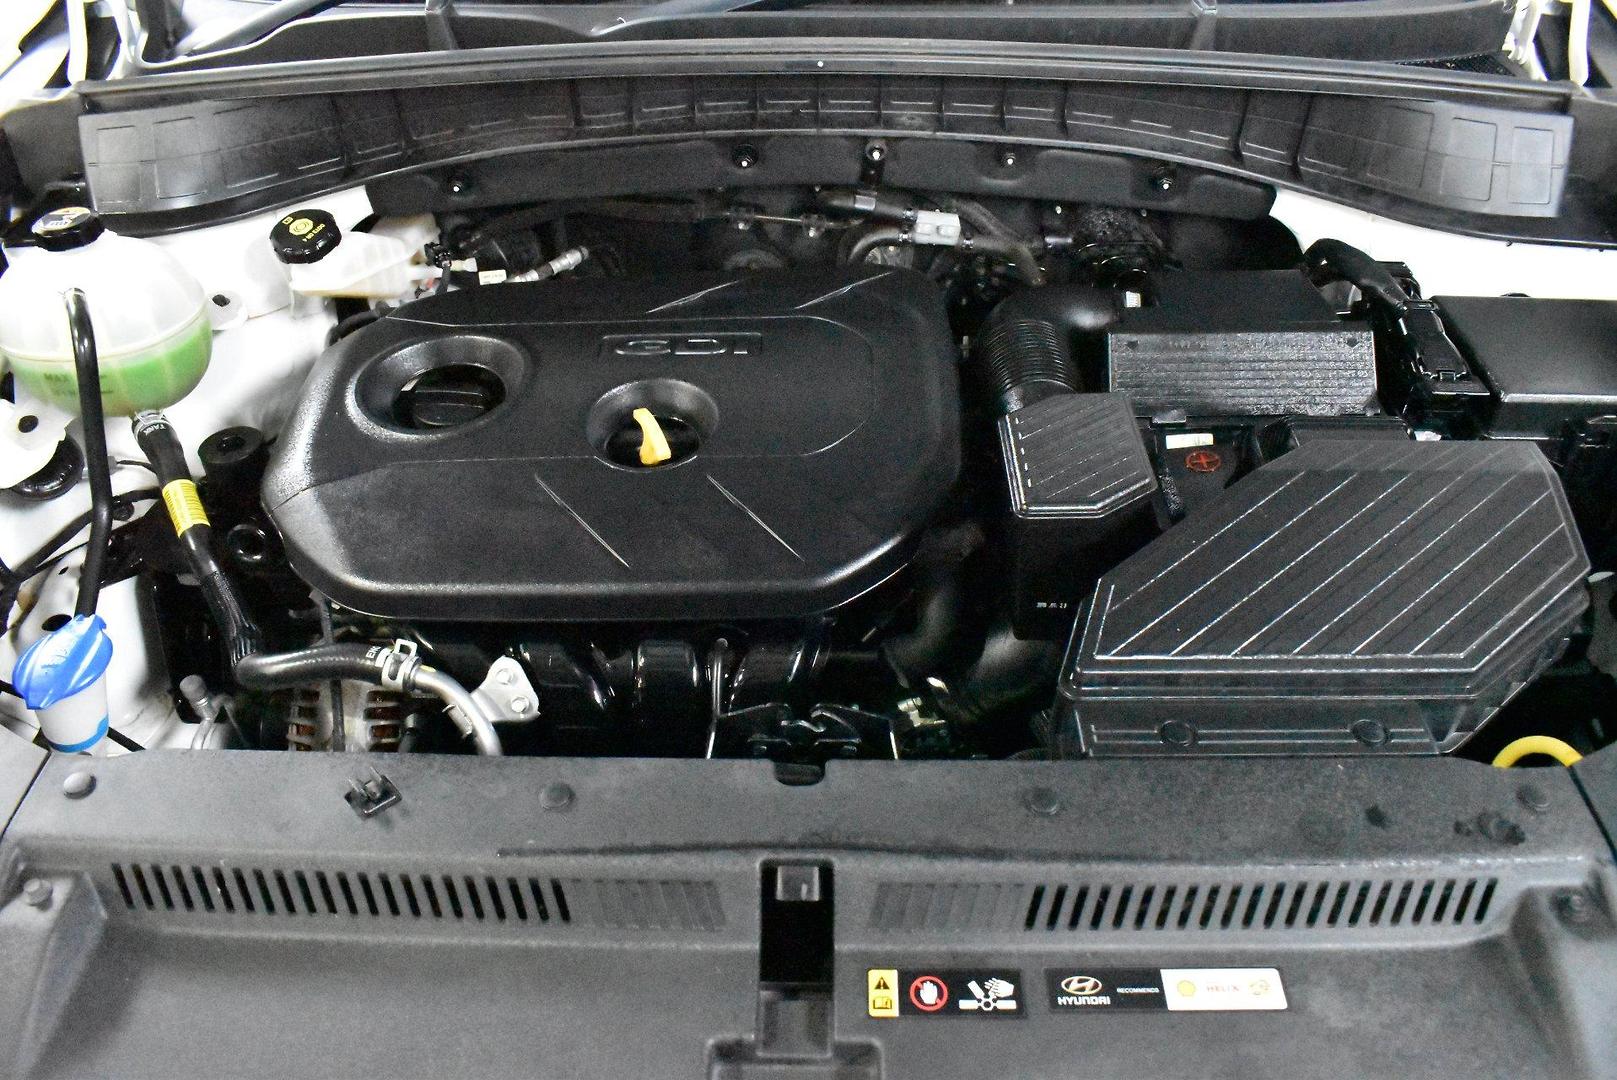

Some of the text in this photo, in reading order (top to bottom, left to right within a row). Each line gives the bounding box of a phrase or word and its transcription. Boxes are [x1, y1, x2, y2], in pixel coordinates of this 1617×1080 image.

[143, 423, 167, 436] TANK
[1058, 996, 1111, 1005] HYUNDAI
[1206, 984, 1240, 993] HELIX
